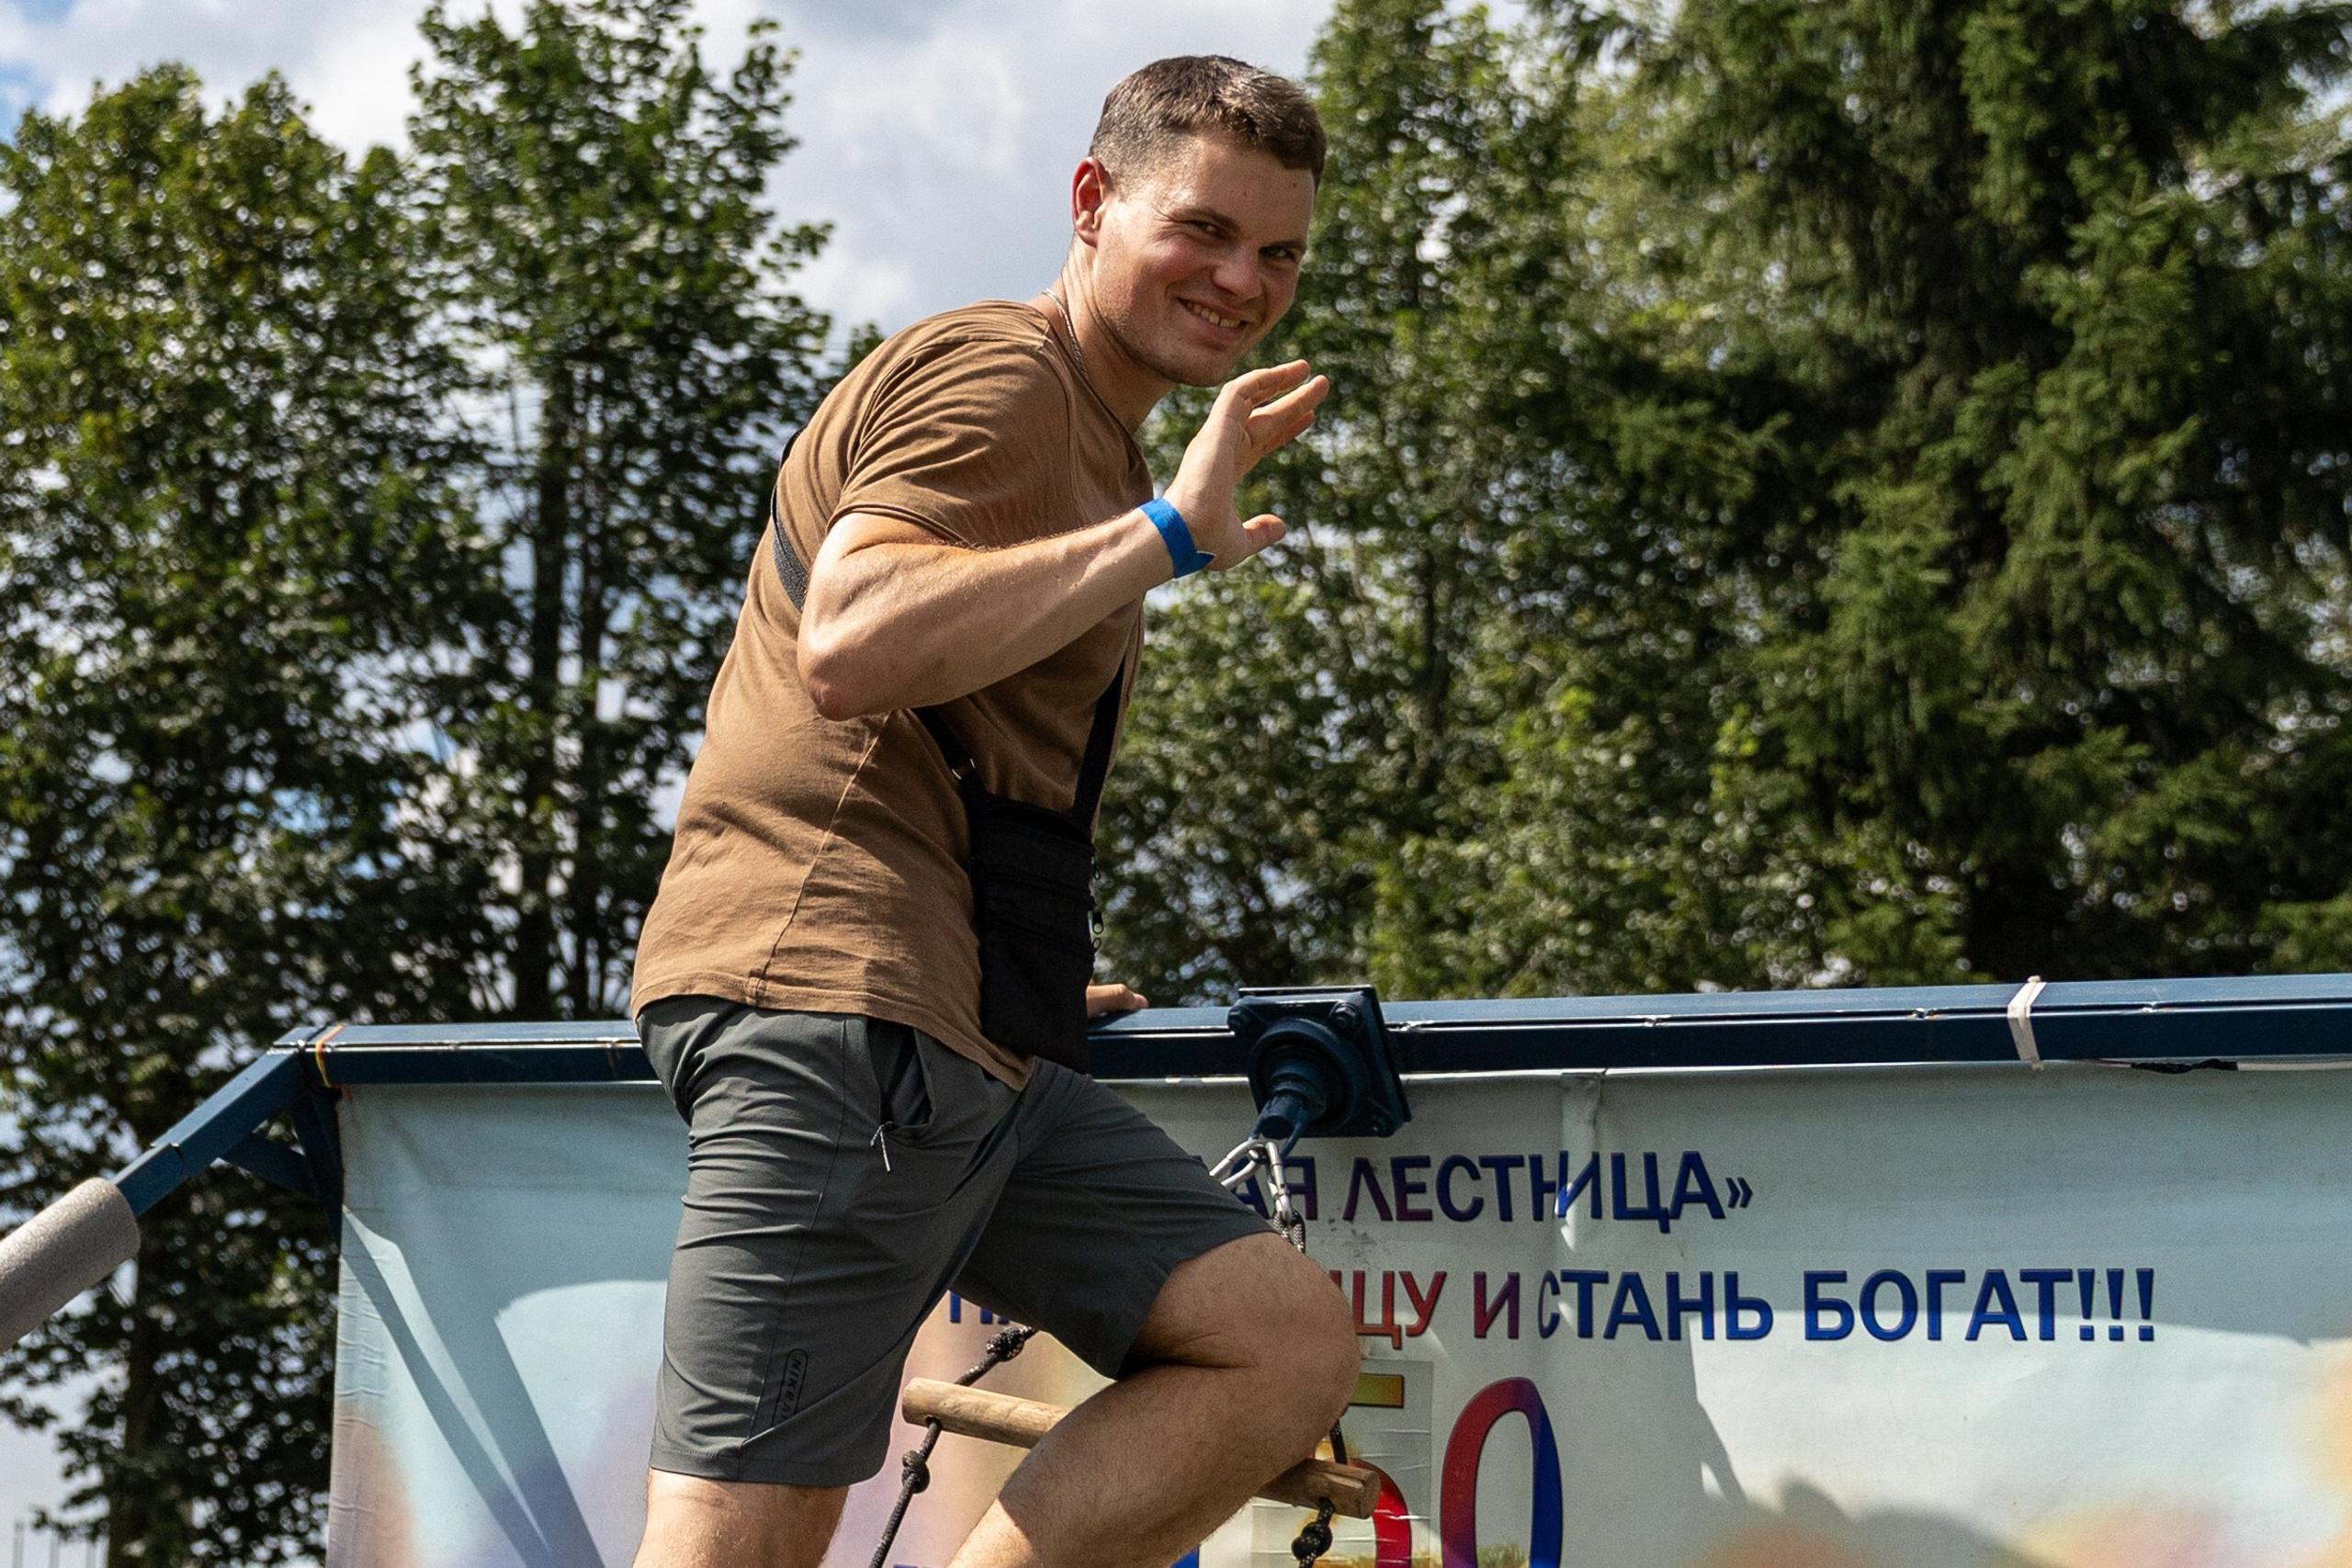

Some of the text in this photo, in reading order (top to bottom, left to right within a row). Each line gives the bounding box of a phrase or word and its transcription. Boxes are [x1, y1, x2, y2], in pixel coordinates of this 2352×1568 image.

[1342, 1150, 1753, 1235] ЛЕСТНИЦА»
[1329, 1268, 2154, 1350] ЦУ И СТАНЬ БОГАТ!!!
